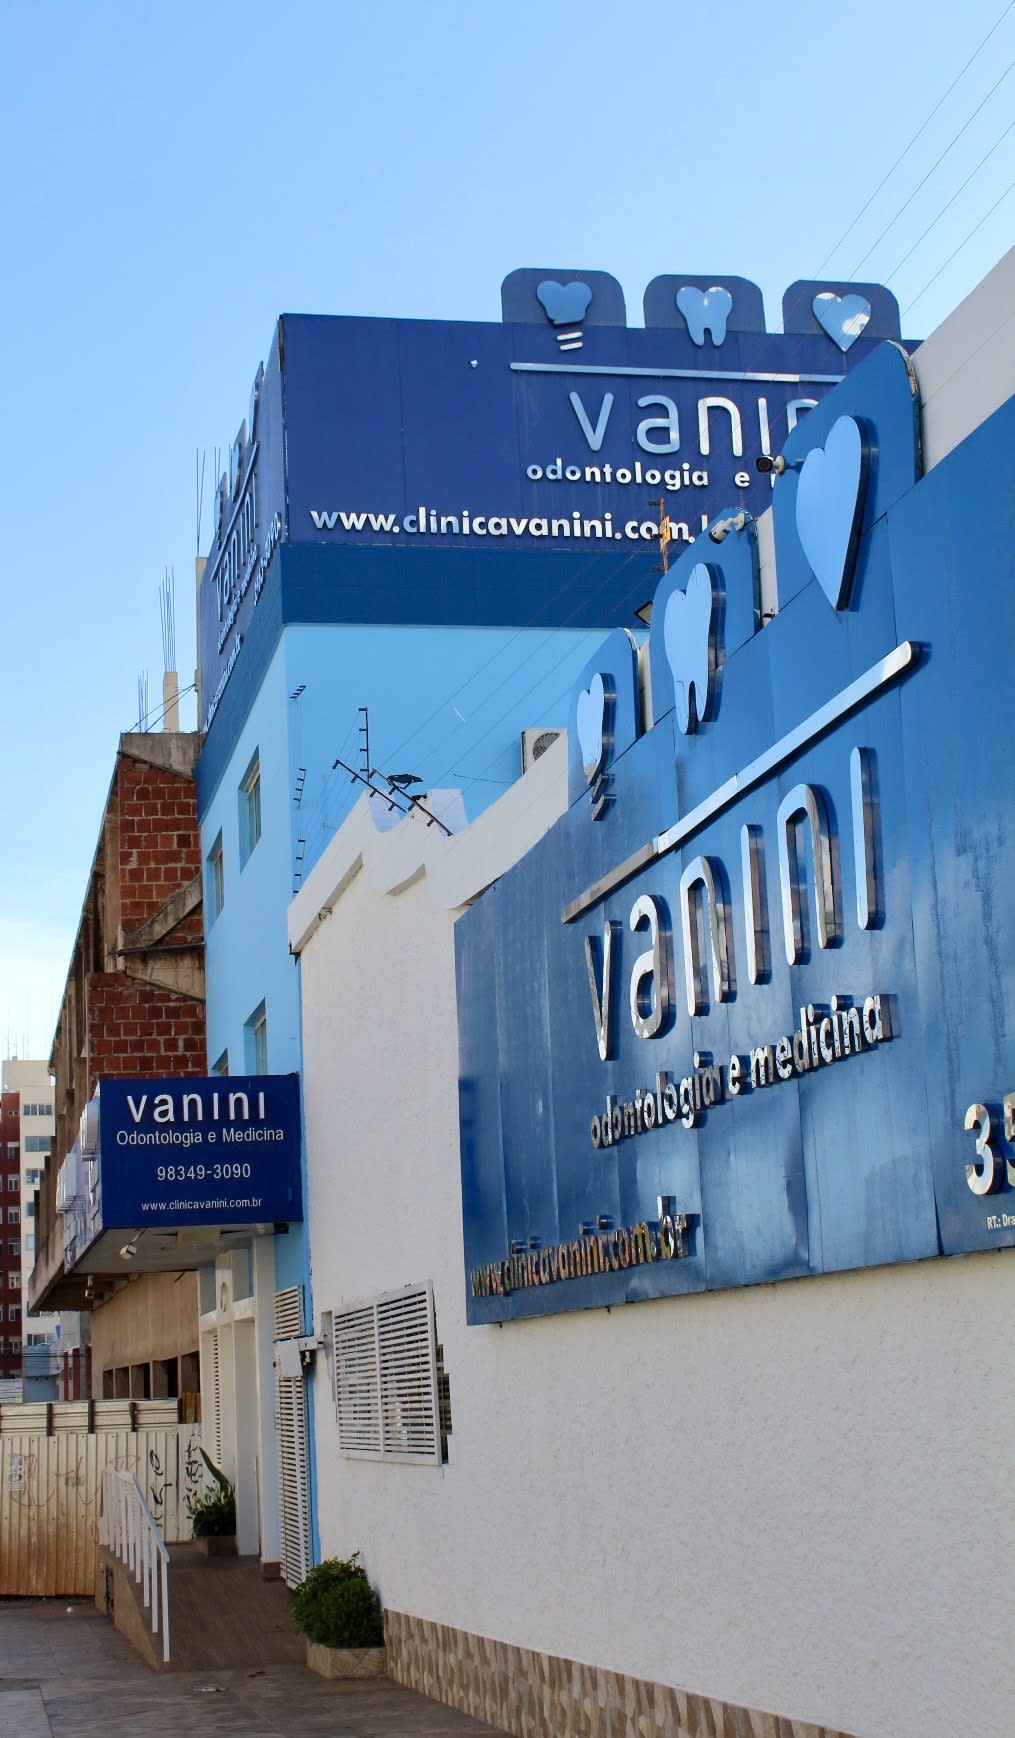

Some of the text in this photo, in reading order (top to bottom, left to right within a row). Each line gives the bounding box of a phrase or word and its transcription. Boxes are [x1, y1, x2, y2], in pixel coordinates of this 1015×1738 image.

[526, 458, 708, 491] odontologia
[734, 471, 750, 488] e
[310, 506, 708, 544] www.clinicavanini.com.
[584, 747, 883, 1061] vanini
[591, 994, 892, 1149] odontologia e medicina
[126, 1091, 265, 1124] vanini
[116, 1127, 284, 1148] Odontologia e Medicina
[157, 1163, 251, 1181] 98349-3090
[141, 1196, 263, 1212] www.clinicavanini.com.br
